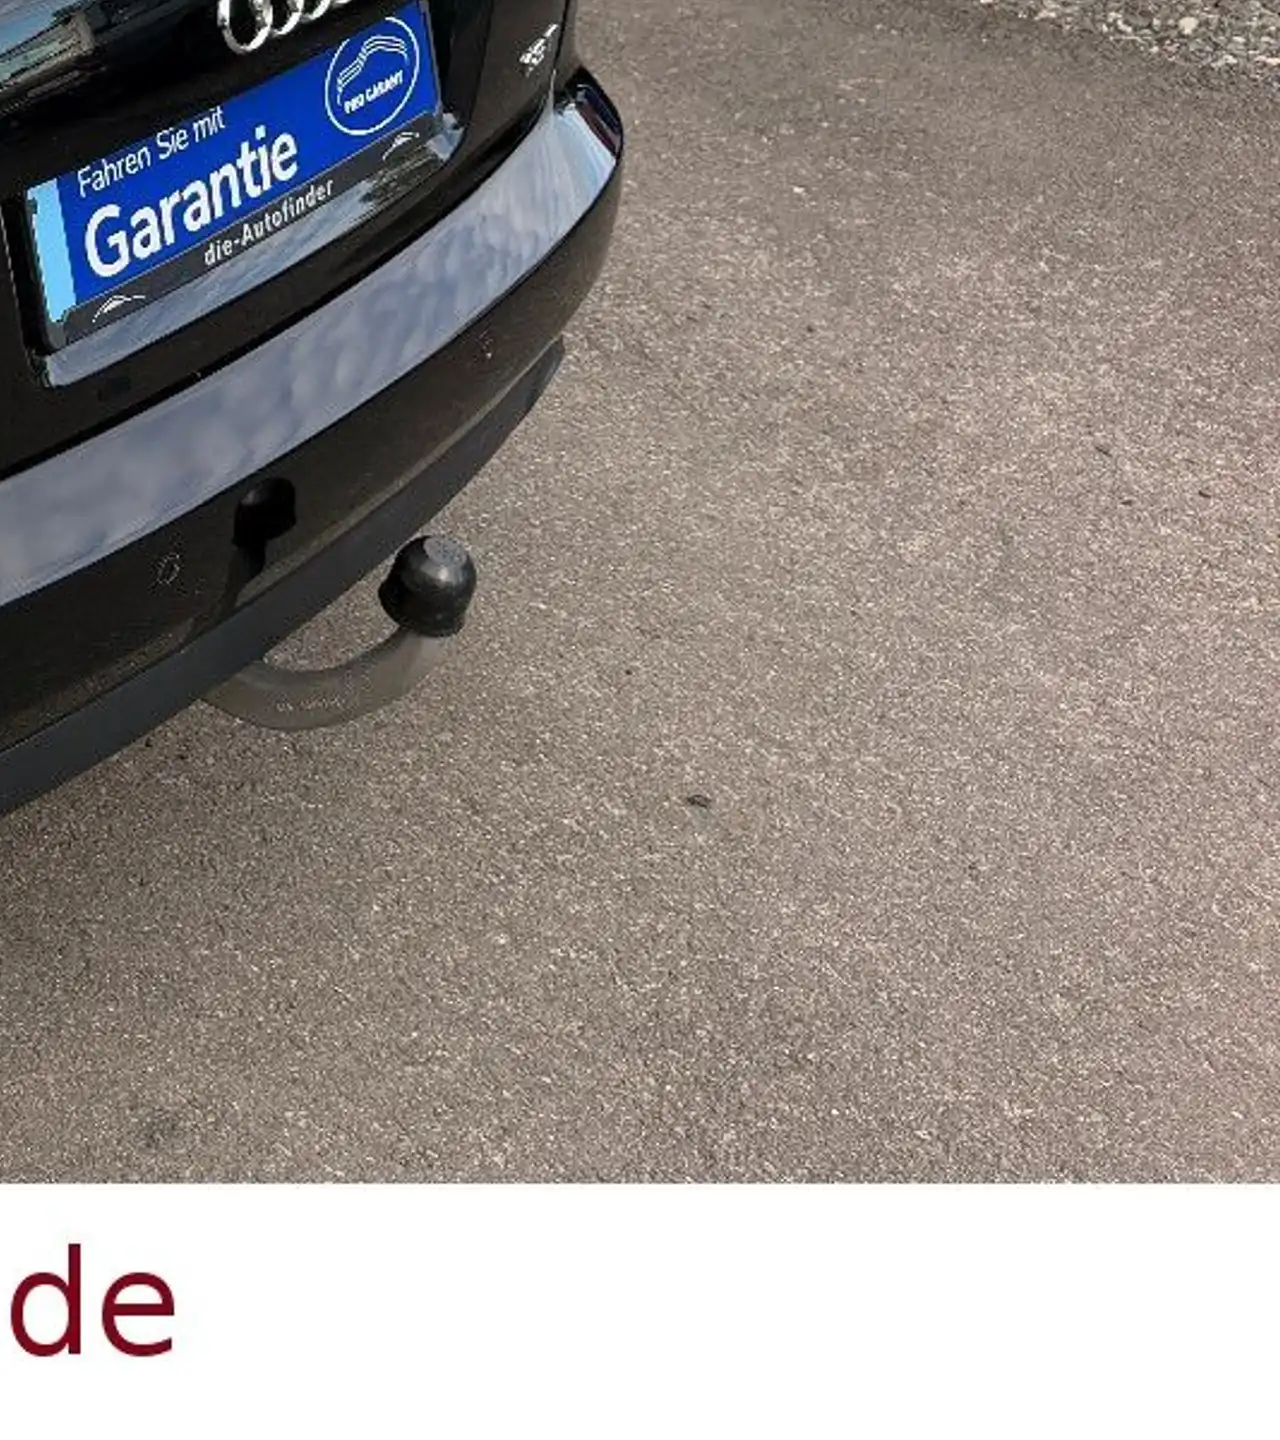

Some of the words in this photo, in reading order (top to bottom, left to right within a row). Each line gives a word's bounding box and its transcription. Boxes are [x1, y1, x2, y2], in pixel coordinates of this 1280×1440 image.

[344, 93, 365, 115] PRO
[366, 69, 403, 102] GARANT
[77, 143, 151, 198] Fahren
[156, 127, 189, 160] Sie
[192, 105, 226, 144] mit
[84, 124, 300, 278] Garantie
[204, 179, 335, 266] die-Autofinder
